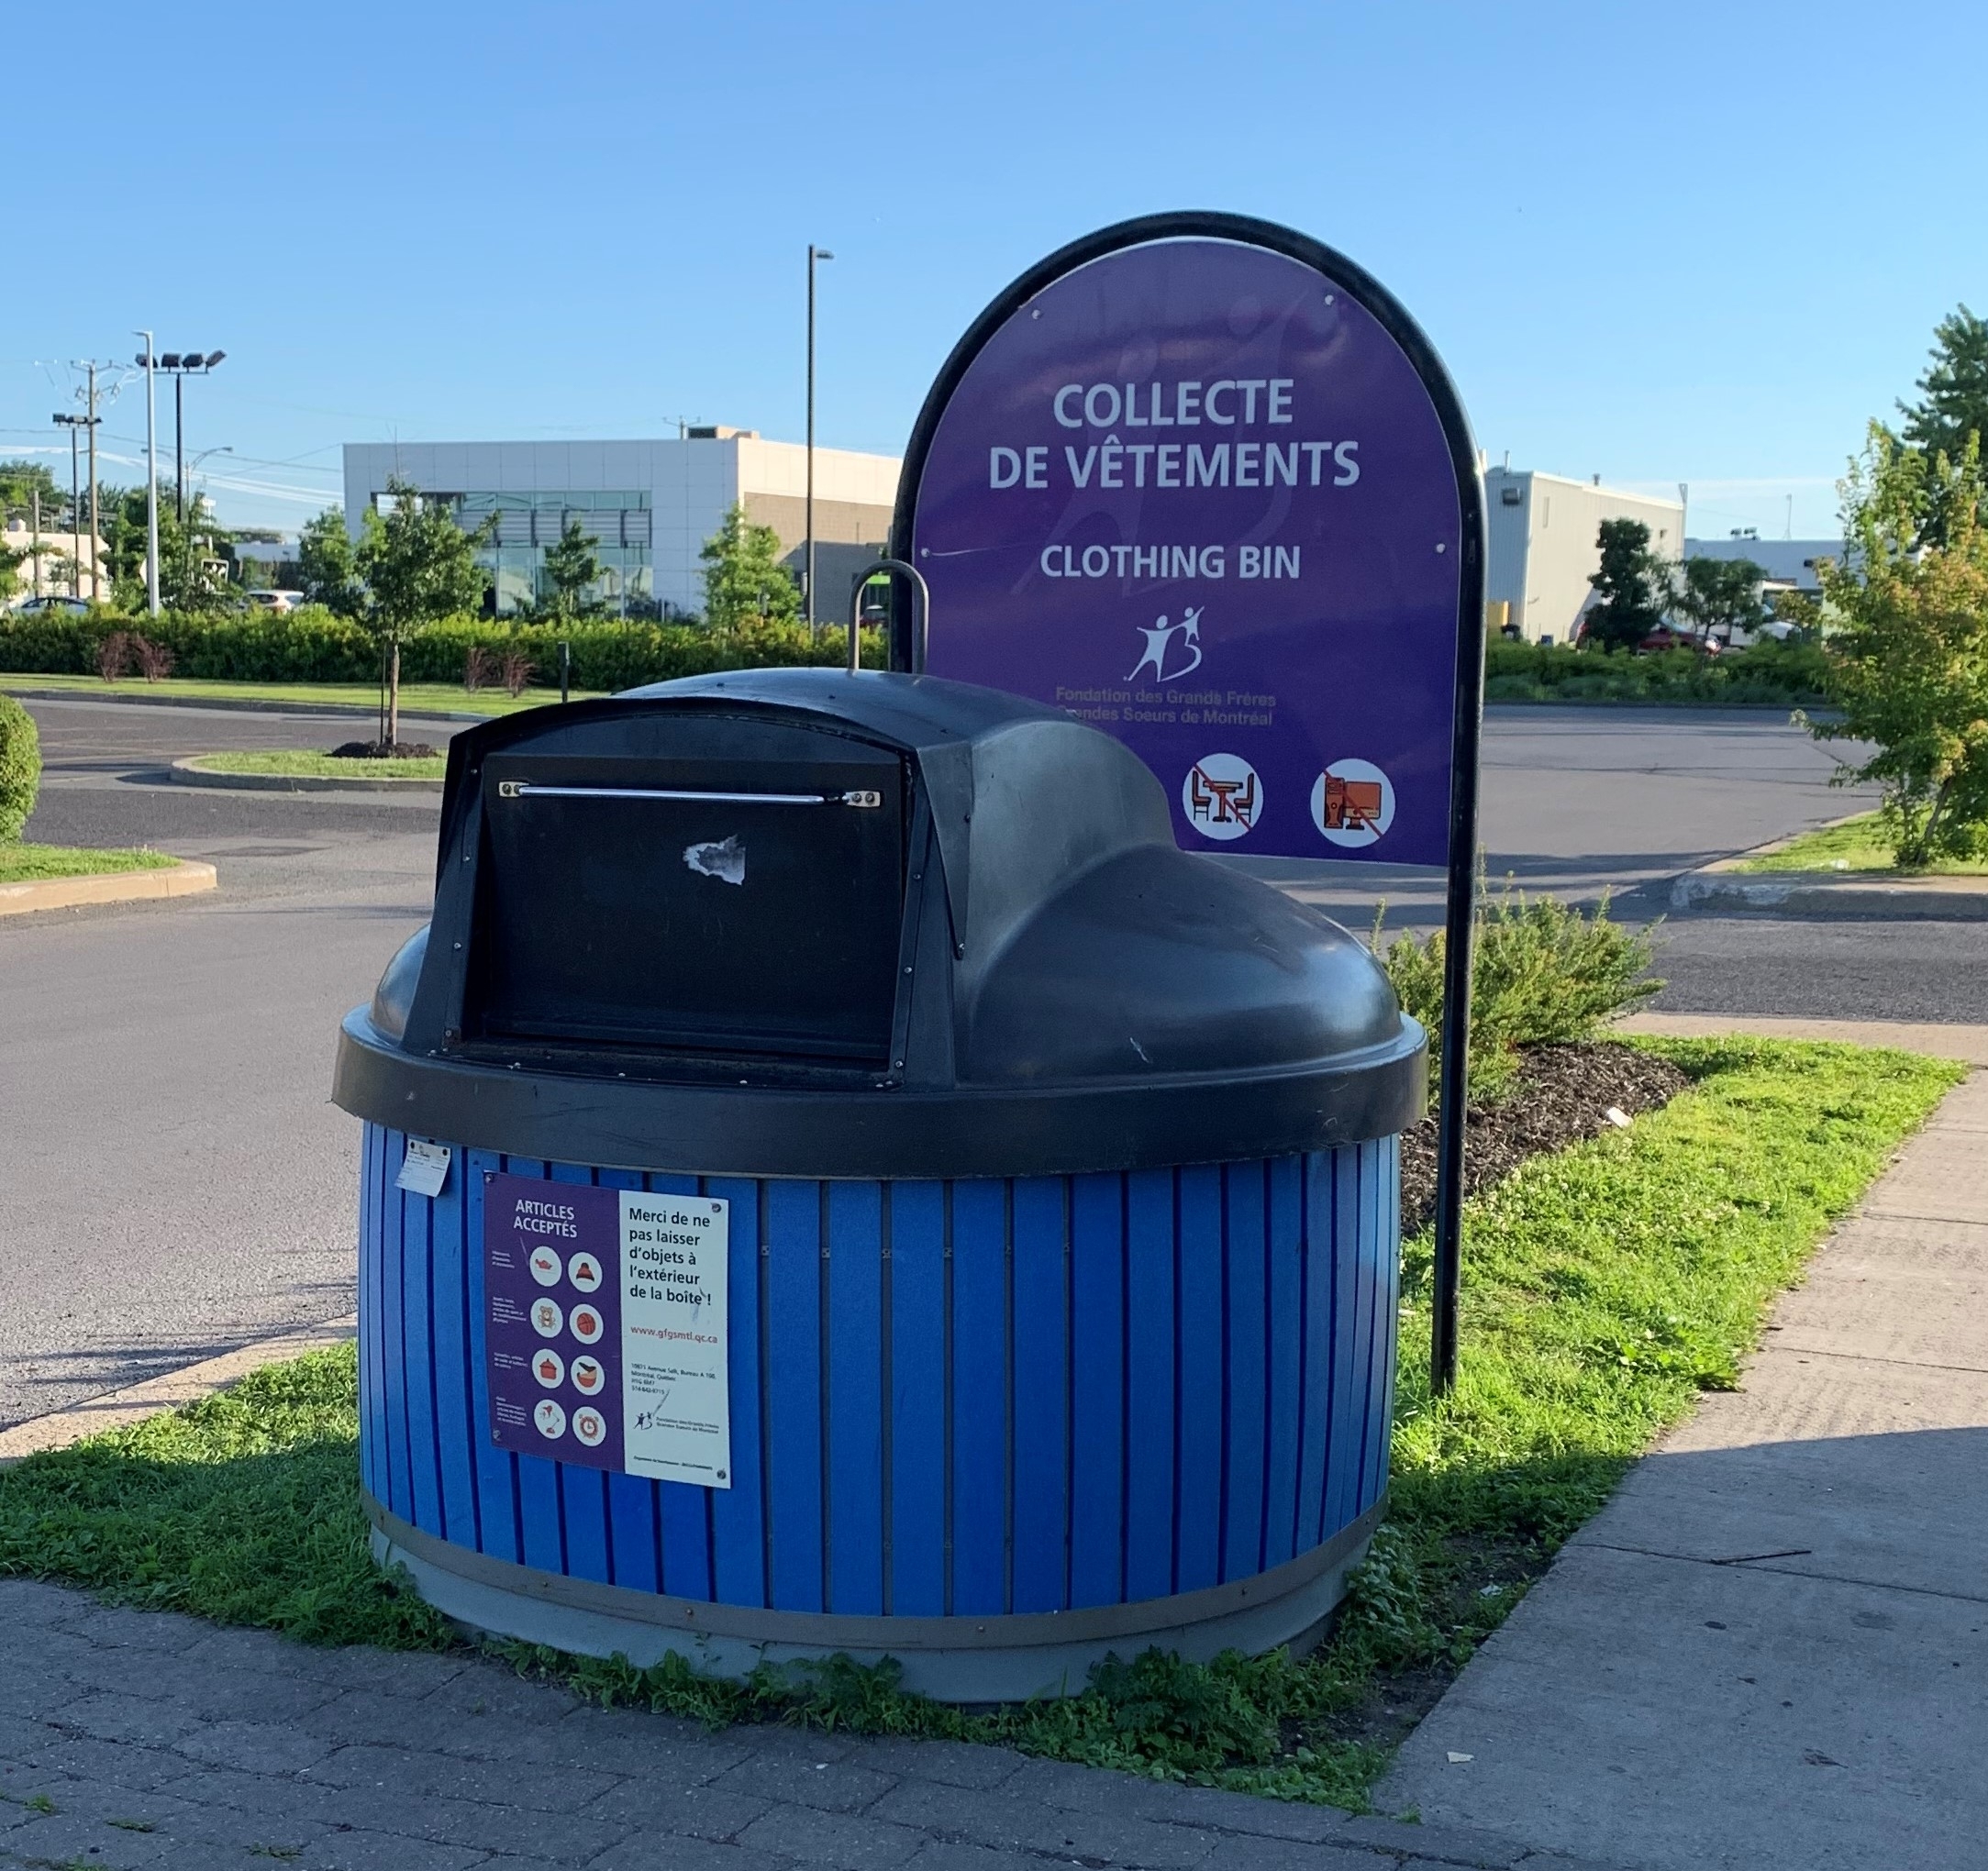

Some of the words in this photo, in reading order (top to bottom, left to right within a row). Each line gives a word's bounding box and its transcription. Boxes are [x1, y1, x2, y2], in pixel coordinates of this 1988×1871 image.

[1053, 379, 1294, 427] COLLECTE
[990, 447, 1049, 489] DE
[1065, 434, 1361, 488] VÊTEMENTS
[1040, 545, 1226, 579] CLOTHING
[1238, 545, 1301, 579] BIN
[1056, 687, 1131, 703] Fondation
[1135, 689, 1163, 703] des
[1166, 690, 1222, 705] Grands
[1227, 691, 1276, 706] Frères
[1057, 705, 1118, 721] andes
[1123, 706, 1176, 723] Soeurs
[1180, 709, 1200, 724] de
[1203, 709, 1272, 725] Montréal
[515, 1199, 575, 1221] ARTICLES
[629, 1207, 667, 1223] Merci
[671, 1211, 689, 1225] de
[693, 1216, 711, 1228] ne
[513, 1215, 577, 1238] ACCEPTÉS
[629, 1229, 652, 1243] pas
[656, 1228, 701, 1246] laisser
[688, 1251, 696, 1266] à
[629, 1284, 647, 1299] de
[650, 1286, 662, 1301] la
[666, 1288, 703, 1305] boîte
[706, 1293, 712, 1306] !
[630, 1326, 718, 1344] www.gfgsmtl.qc.ca
